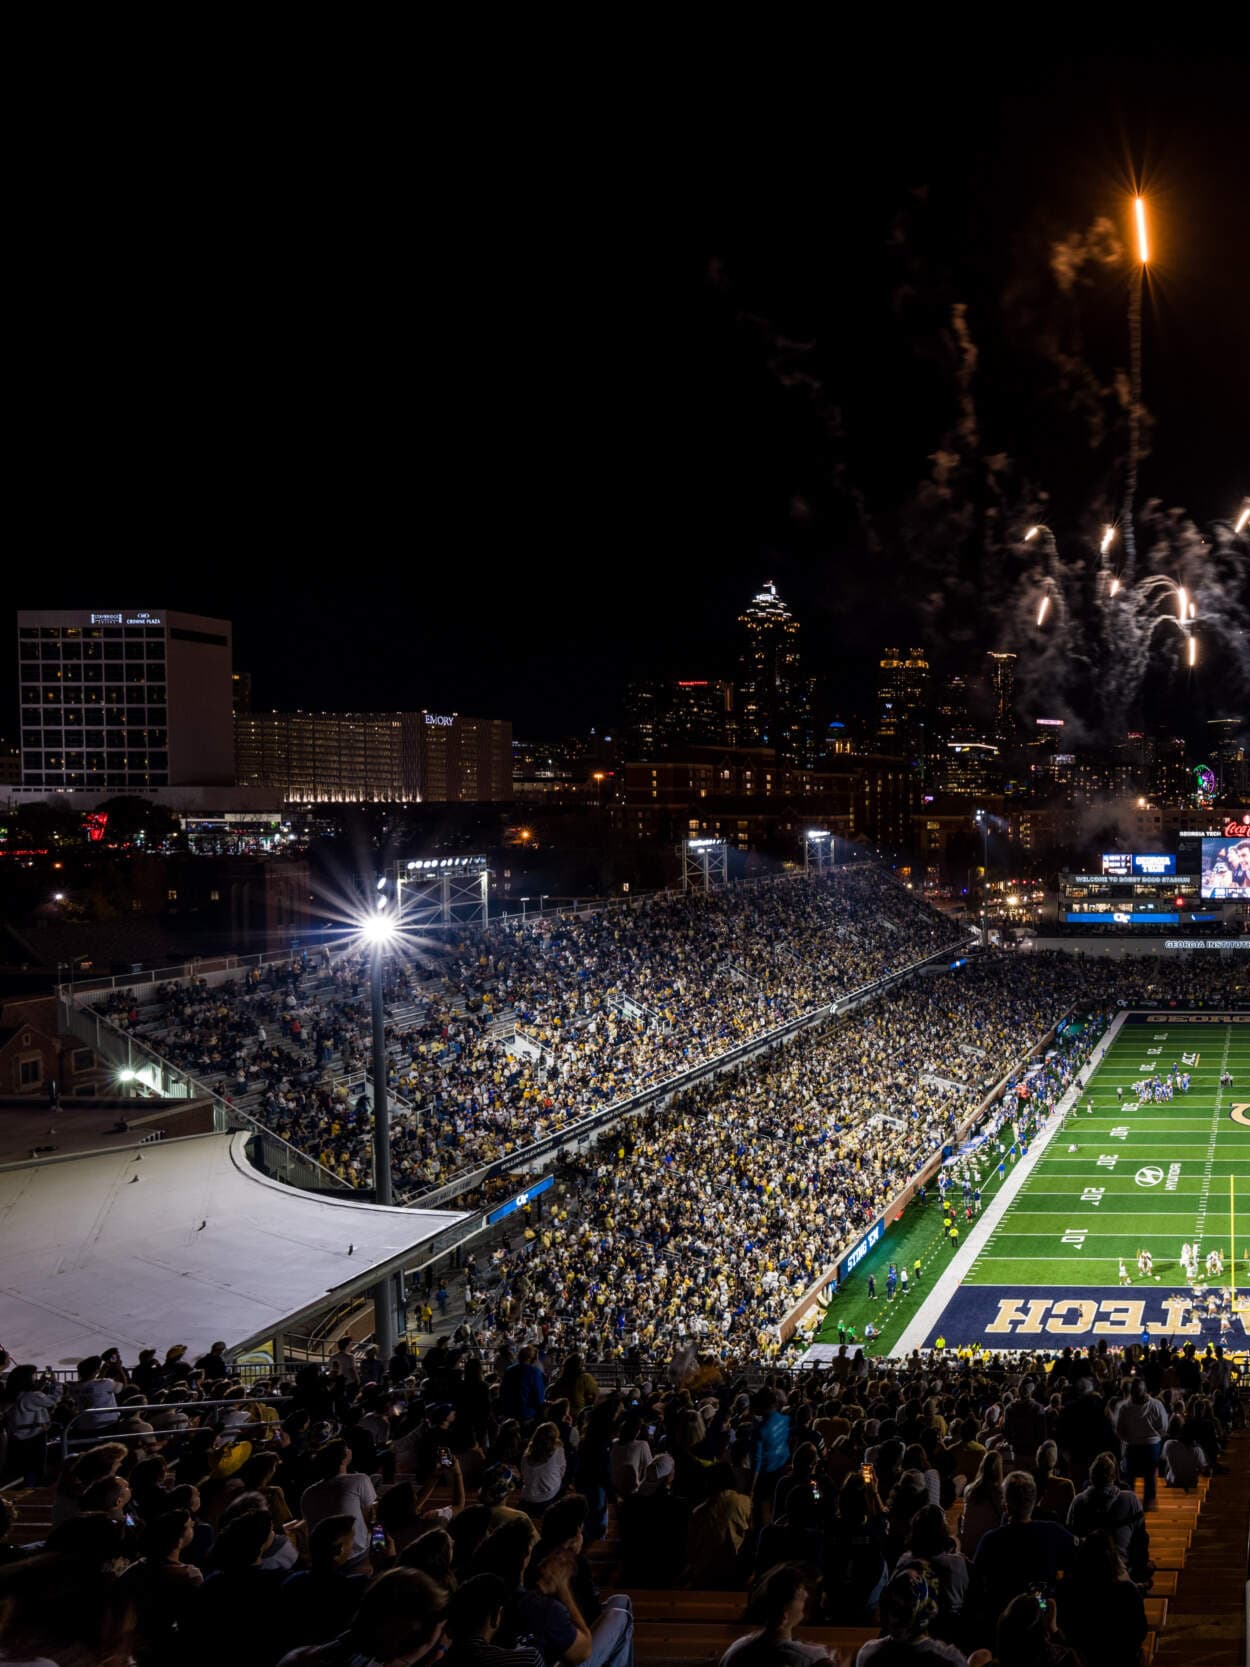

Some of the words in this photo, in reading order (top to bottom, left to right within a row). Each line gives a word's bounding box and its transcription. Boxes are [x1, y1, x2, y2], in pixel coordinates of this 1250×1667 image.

[425, 714, 454, 727] EMORY
[1165, 940, 1206, 949] GEORGIA
[1080, 1187, 1105, 1200] 20
[1061, 1229, 1088, 1242] 10
[847, 1239, 867, 1272] STING
[984, 1299, 1202, 1335] TECH
